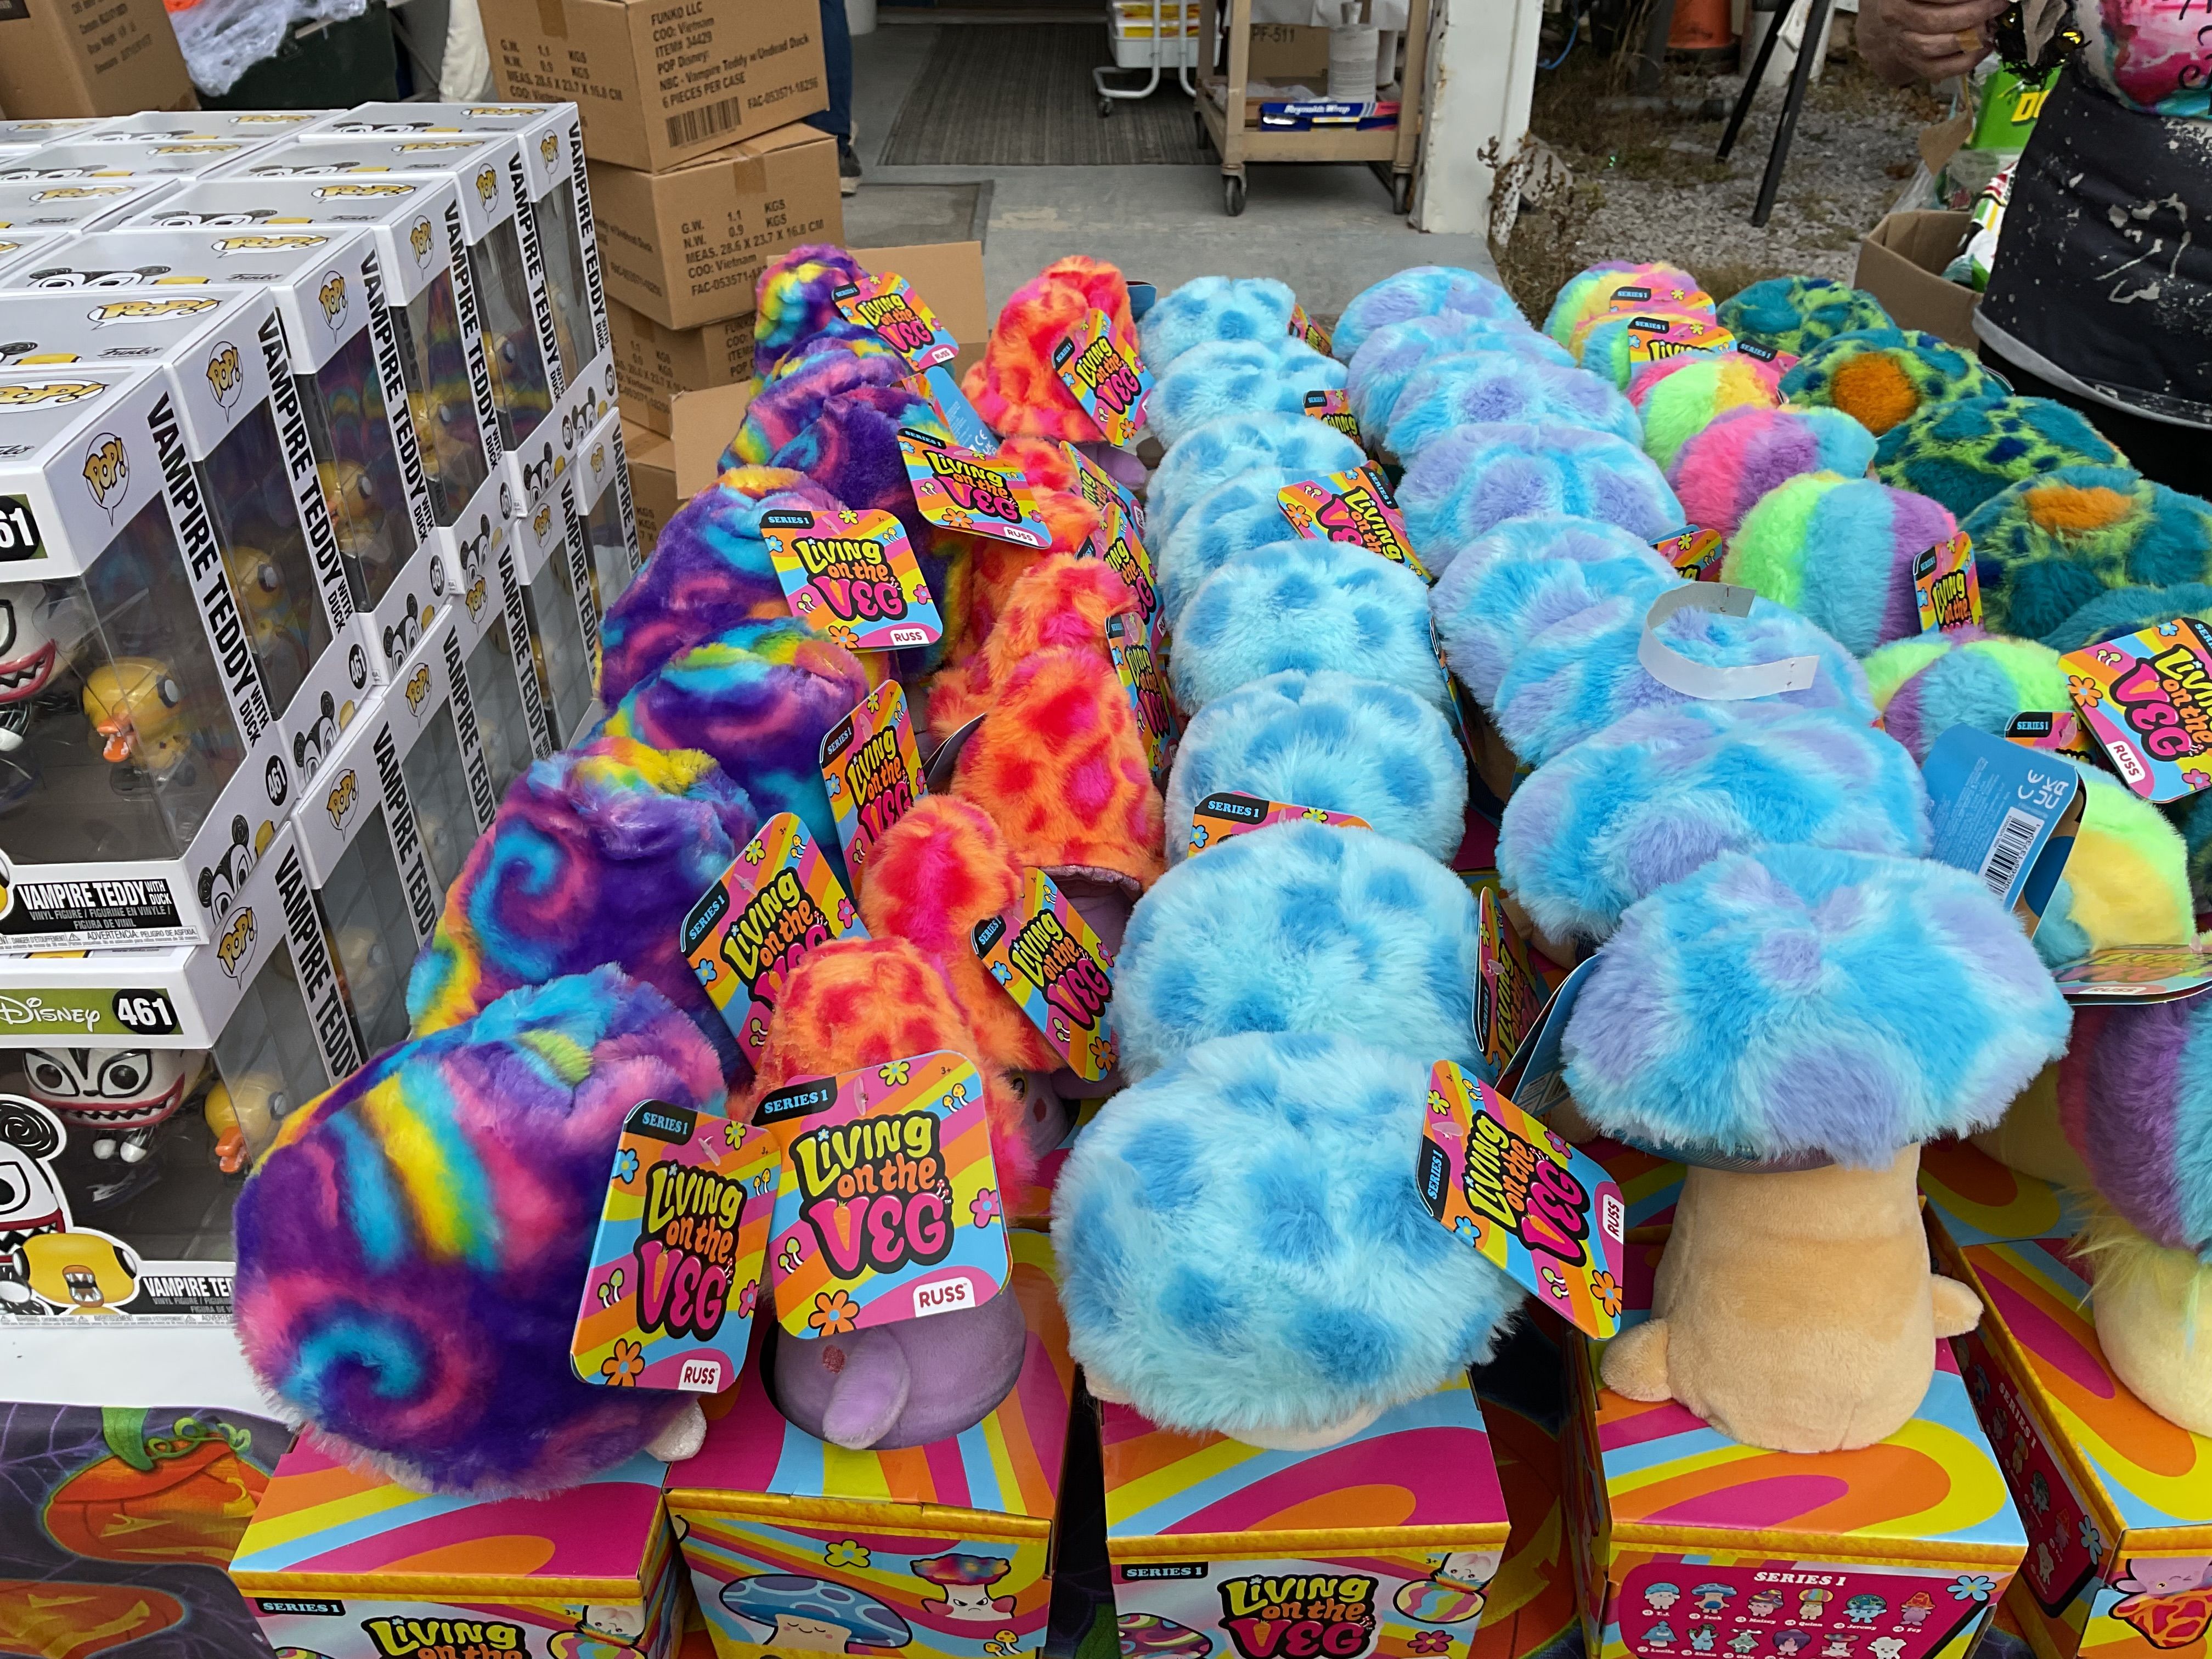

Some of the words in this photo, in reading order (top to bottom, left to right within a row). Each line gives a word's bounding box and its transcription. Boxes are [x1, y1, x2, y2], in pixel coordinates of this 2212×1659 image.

[686, 1, 702, 16] LLC
[657, 58, 675, 75] POP
[685, 65, 720, 83] Vampire
[723, 54, 747, 71] Teddy
[789, 33, 809, 49] Duck
[670, 86, 702, 106] PIECES
[703, 80, 721, 95] PER
[722, 71, 746, 89] CASE
[568, 121, 594, 235] VAMPIRE
[584, 237, 606, 322] TEDDY
[681, 219, 704, 234] G.W.
[727, 210, 742, 222] 1.1
[764, 199, 785, 213] KGS
[743, 238, 752, 249] X
[776, 230, 784, 240] X
[808, 219, 823, 232] CM
[766, 214, 787, 228] KGS
[508, 151, 543, 279] VAMPIRE
[533, 280, 561, 366] TEDDY
[715, 253, 757, 271] Vietnam
[100, 300, 220, 319] POP!
[319, 276, 347, 321] POP!
[444, 199, 479, 337] VAMPIRE
[468, 337, 498, 434] TEDDY
[493, 427, 504, 461] WITH
[1635, 320, 1660, 330] SERIES
[206, 347, 241, 403] POP!
[360, 249, 401, 403] VAMPIRE
[392, 399, 428, 501] TEDDY
[420, 495, 434, 533] WITH
[83, 437, 126, 504] POP!
[257, 311, 309, 481] VAMPIRE
[300, 476, 341, 587] TEDDY
[337, 578, 353, 619] WITH
[486, 436, 498, 470] DUCK
[939, 476, 1018, 520] VEG
[953, 472, 974, 487] on
[976, 478, 1009, 499] the
[414, 503, 428, 544] DUCK
[768, 516, 804, 524] SERIES
[1007, 528, 1033, 543] RUSS
[147, 391, 219, 582] VAMPIRE
[202, 571, 256, 697] TEDDY
[250, 684, 269, 730] WITH
[828, 562, 854, 579] on
[853, 559, 889, 583] the
[328, 585, 345, 630] DUCK
[814, 575, 904, 618] VEG
[498, 545, 529, 665] VAMPIRE
[520, 664, 546, 742] TEDDY
[894, 631, 923, 642] RUSS
[351, 651, 365, 684] 461
[2116, 663, 2192, 757] VEG
[2163, 679, 2192, 707] on
[239, 695, 262, 747] DUCK
[2016, 720, 2045, 731] SERIES
[2112, 744, 2140, 777] RUSS
[267, 760, 286, 800] 461
[373, 721, 419, 865] VAMPIRE
[1208, 800, 1252, 817] SERIES
[1254, 808, 1260, 818] 1
[17, 882, 95, 910] VAMPIRE
[93, 881, 148, 907] TEDDY
[144, 881, 166, 893] WITH
[149, 893, 172, 906] DUCK
[29, 911, 54, 921] VINYL
[55, 910, 82, 920] FIGURE
[89, 908, 125, 918] FIGURINE
[128, 908, 137, 917] EN
[139, 906, 165, 916] VINYLE
[74, 919, 103, 930] FIGURA
[105, 919, 114, 928] DE
[116, 918, 137, 928] VINIL
[274, 844, 331, 1003] VAMPIRE
[689, 898, 720, 940] SERIES
[718, 894, 725, 906] 1
[217, 907, 255, 974] POP!
[759, 935, 785, 964] on
[777, 899, 814, 938] the
[117, 997, 173, 1026] 461
[764, 1092, 819, 1115] SERIES
[821, 1089, 828, 1102] 1
[642, 1112, 682, 1133] SERIES
[682, 1122, 689, 1135] 1
[838, 1163, 879, 1198] on
[879, 1152, 938, 1194] the
[1508, 1138, 1533, 1182] the
[1427, 1158, 1443, 1200] SERIES
[1503, 1176, 1526, 1212] on
[1520, 1158, 1583, 1259] VEG
[1612, 1202, 1621, 1238] RUSS
[666, 1216, 694, 1251] on
[696, 1216, 735, 1265] the
[808, 1191, 947, 1272] VEG
[143, 1277, 207, 1297] VAMPIRE
[640, 1240, 728, 1331] VEG
[919, 1284, 967, 1308] RUSS
[684, 1365, 716, 1386] RUSS
[1126, 1567, 1193, 1579] SERIES
[1195, 1566, 1203, 1577] 1
[1754, 1571, 1833, 1585] SERIES
[1835, 1576, 1847, 1586] 1
[263, 1600, 327, 1614] SERIES
[331, 1603, 341, 1614] 1
[1262, 1601, 1304, 1621] on
[1306, 1597, 1368, 1621] the
[1227, 1618, 1365, 1657] VEG
